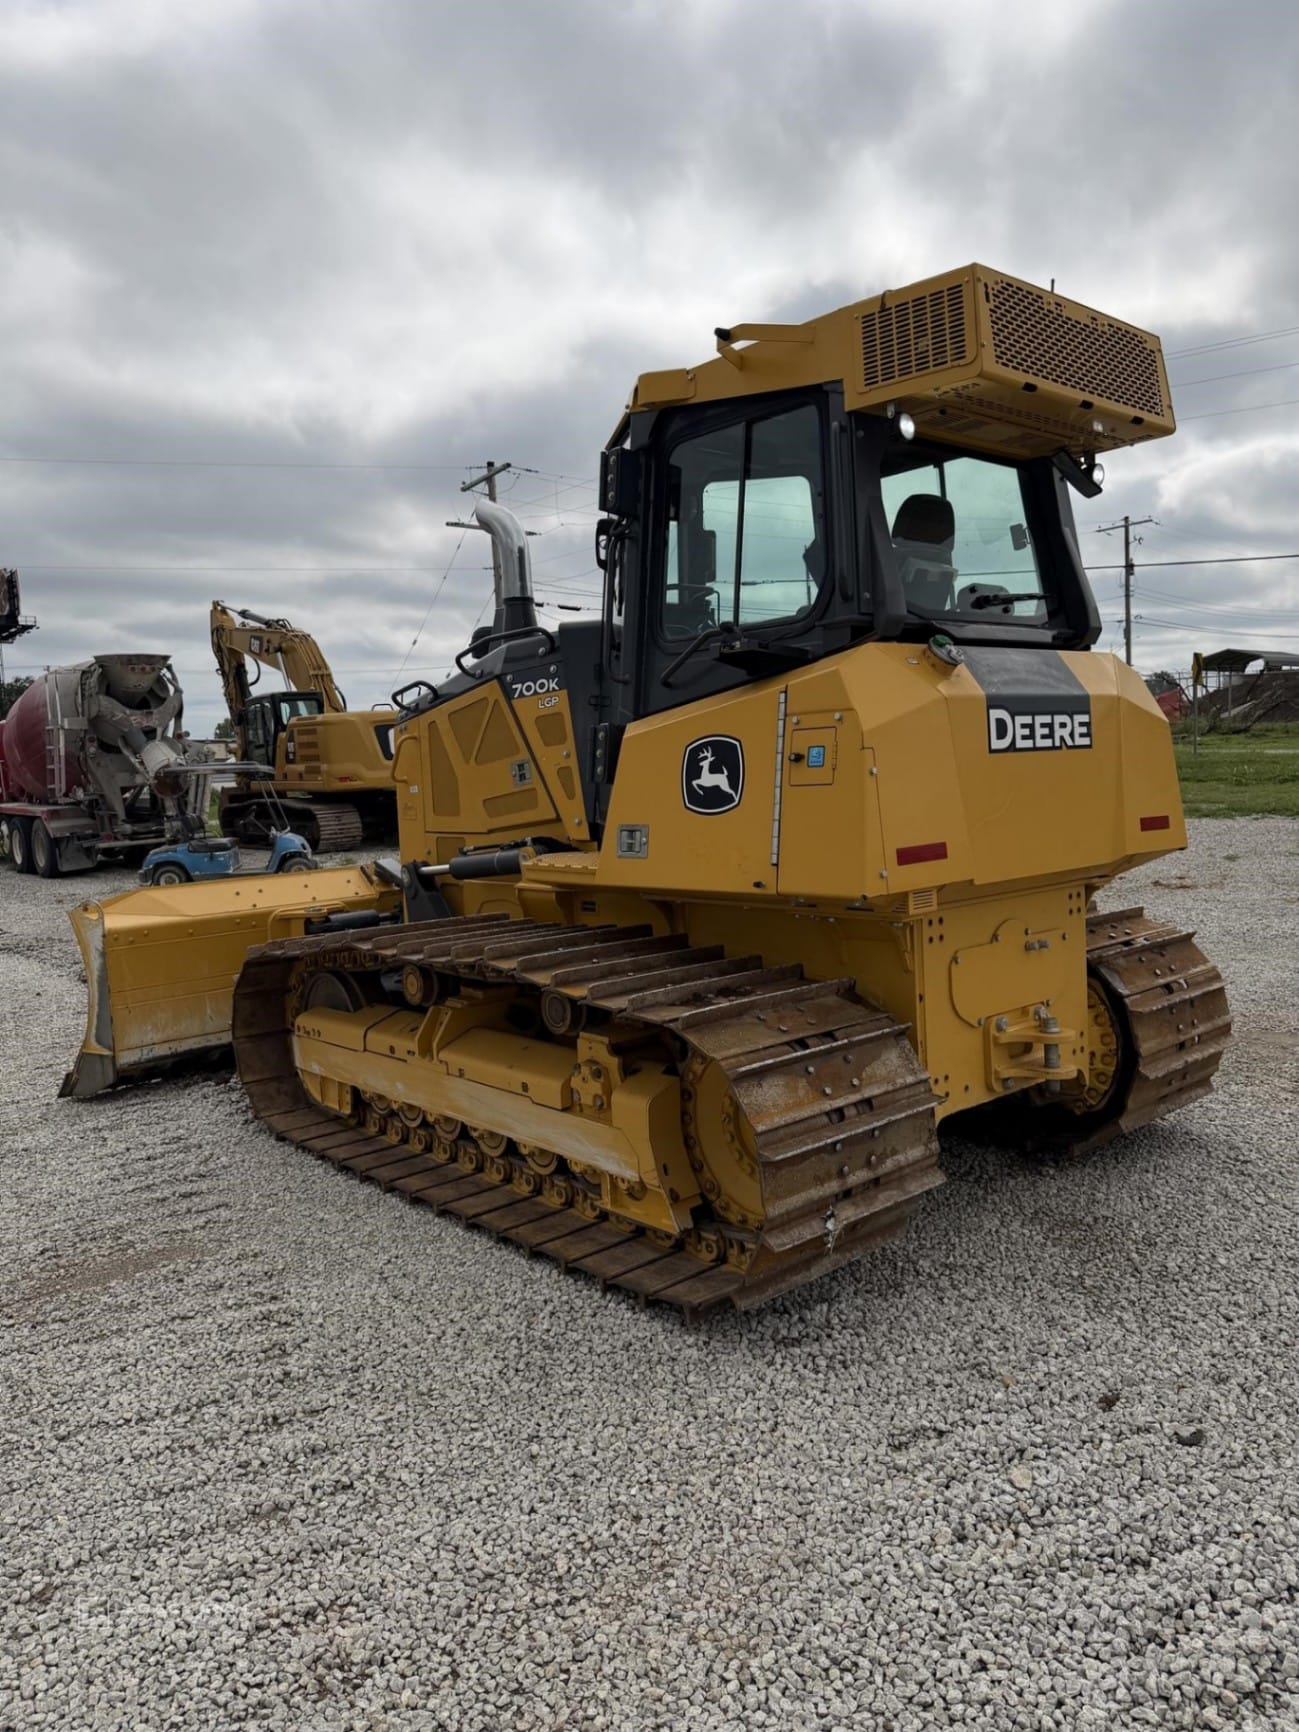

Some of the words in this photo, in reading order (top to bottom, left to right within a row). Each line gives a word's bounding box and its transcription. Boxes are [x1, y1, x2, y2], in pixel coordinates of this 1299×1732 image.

[512, 678, 560, 699] 700K
[538, 696, 559, 709] LGP
[988, 708, 1091, 750] DEERE
